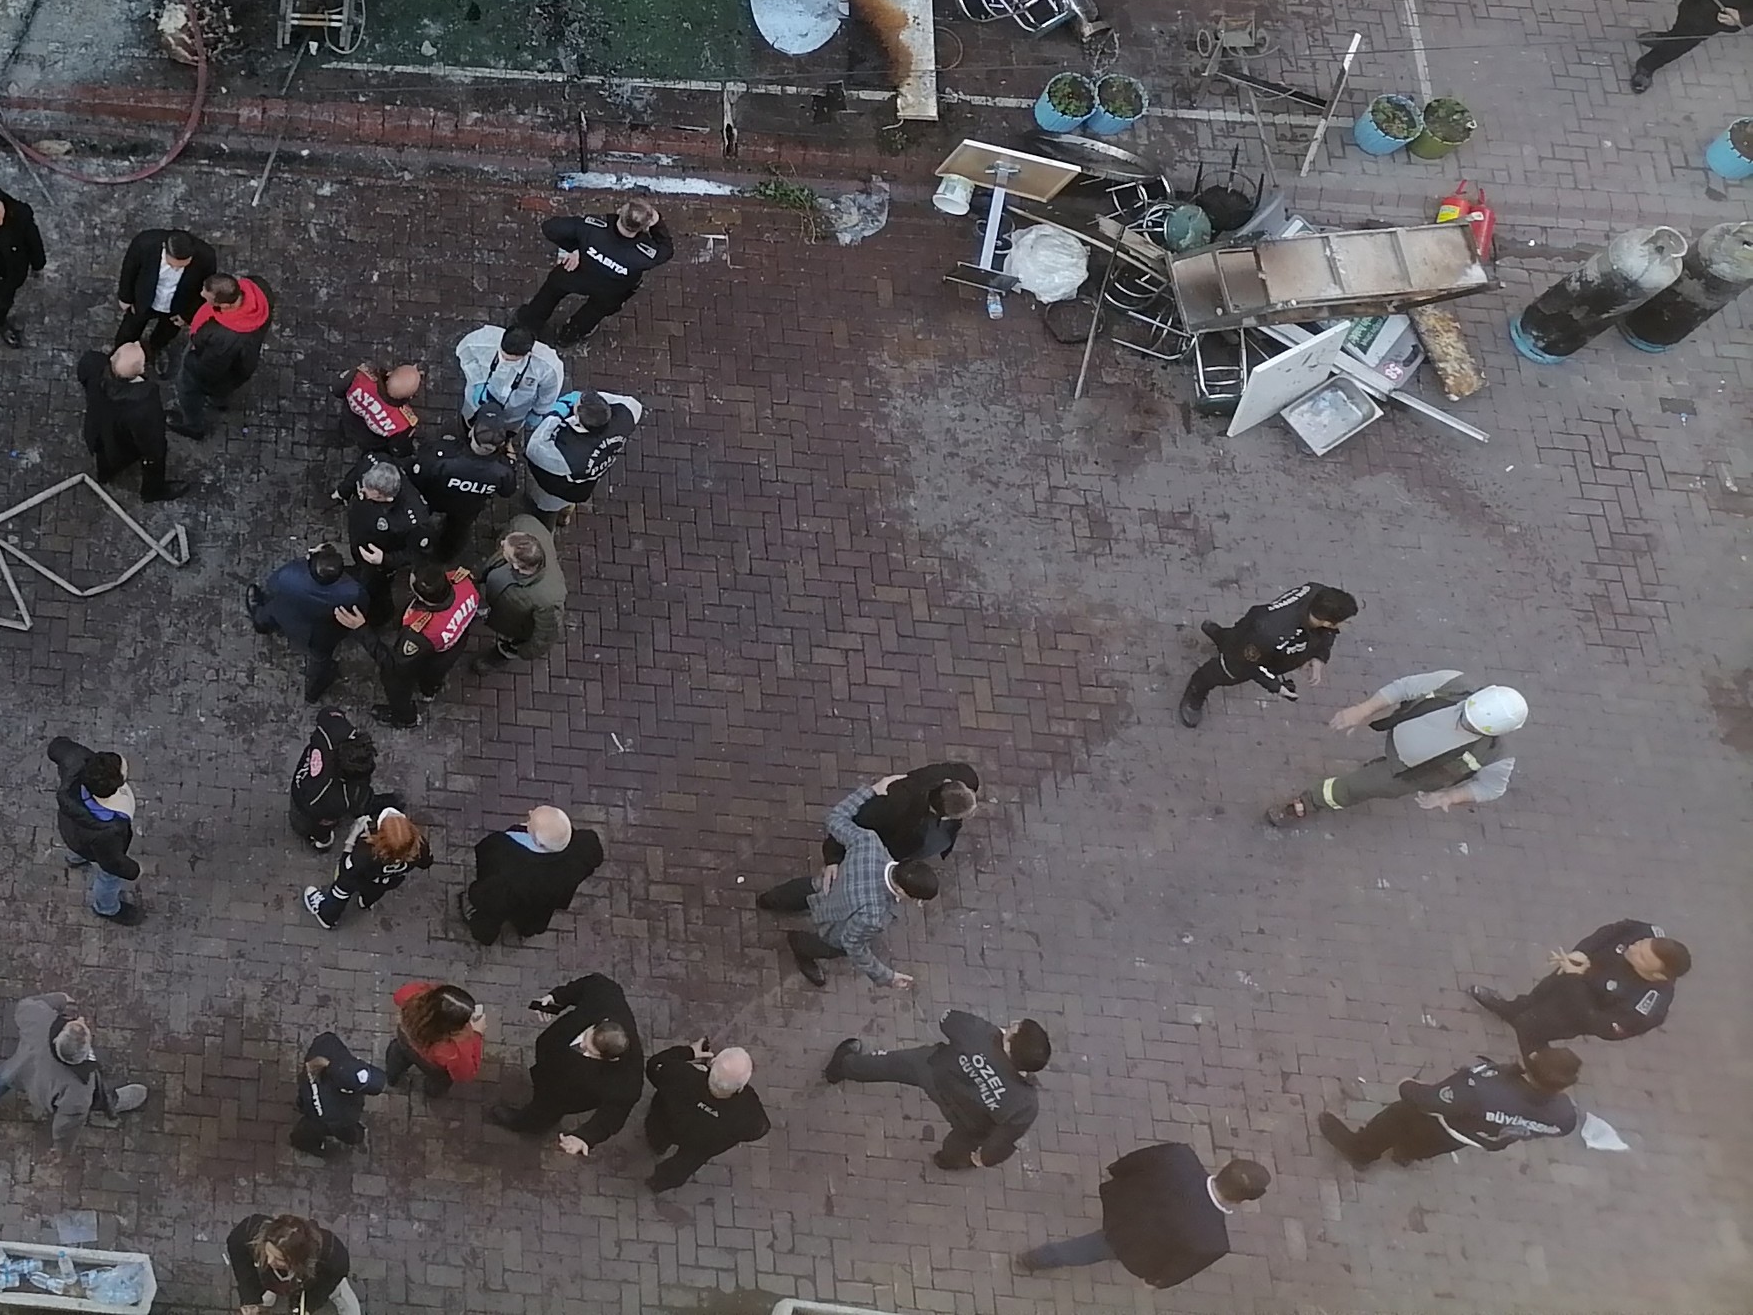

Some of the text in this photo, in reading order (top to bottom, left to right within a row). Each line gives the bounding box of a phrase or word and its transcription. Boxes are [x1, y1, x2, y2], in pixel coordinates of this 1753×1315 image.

[352, 387, 397, 431] AYDIN
[440, 594, 476, 643] AYDIN
[972, 1053, 1006, 1100] ÖZEL
